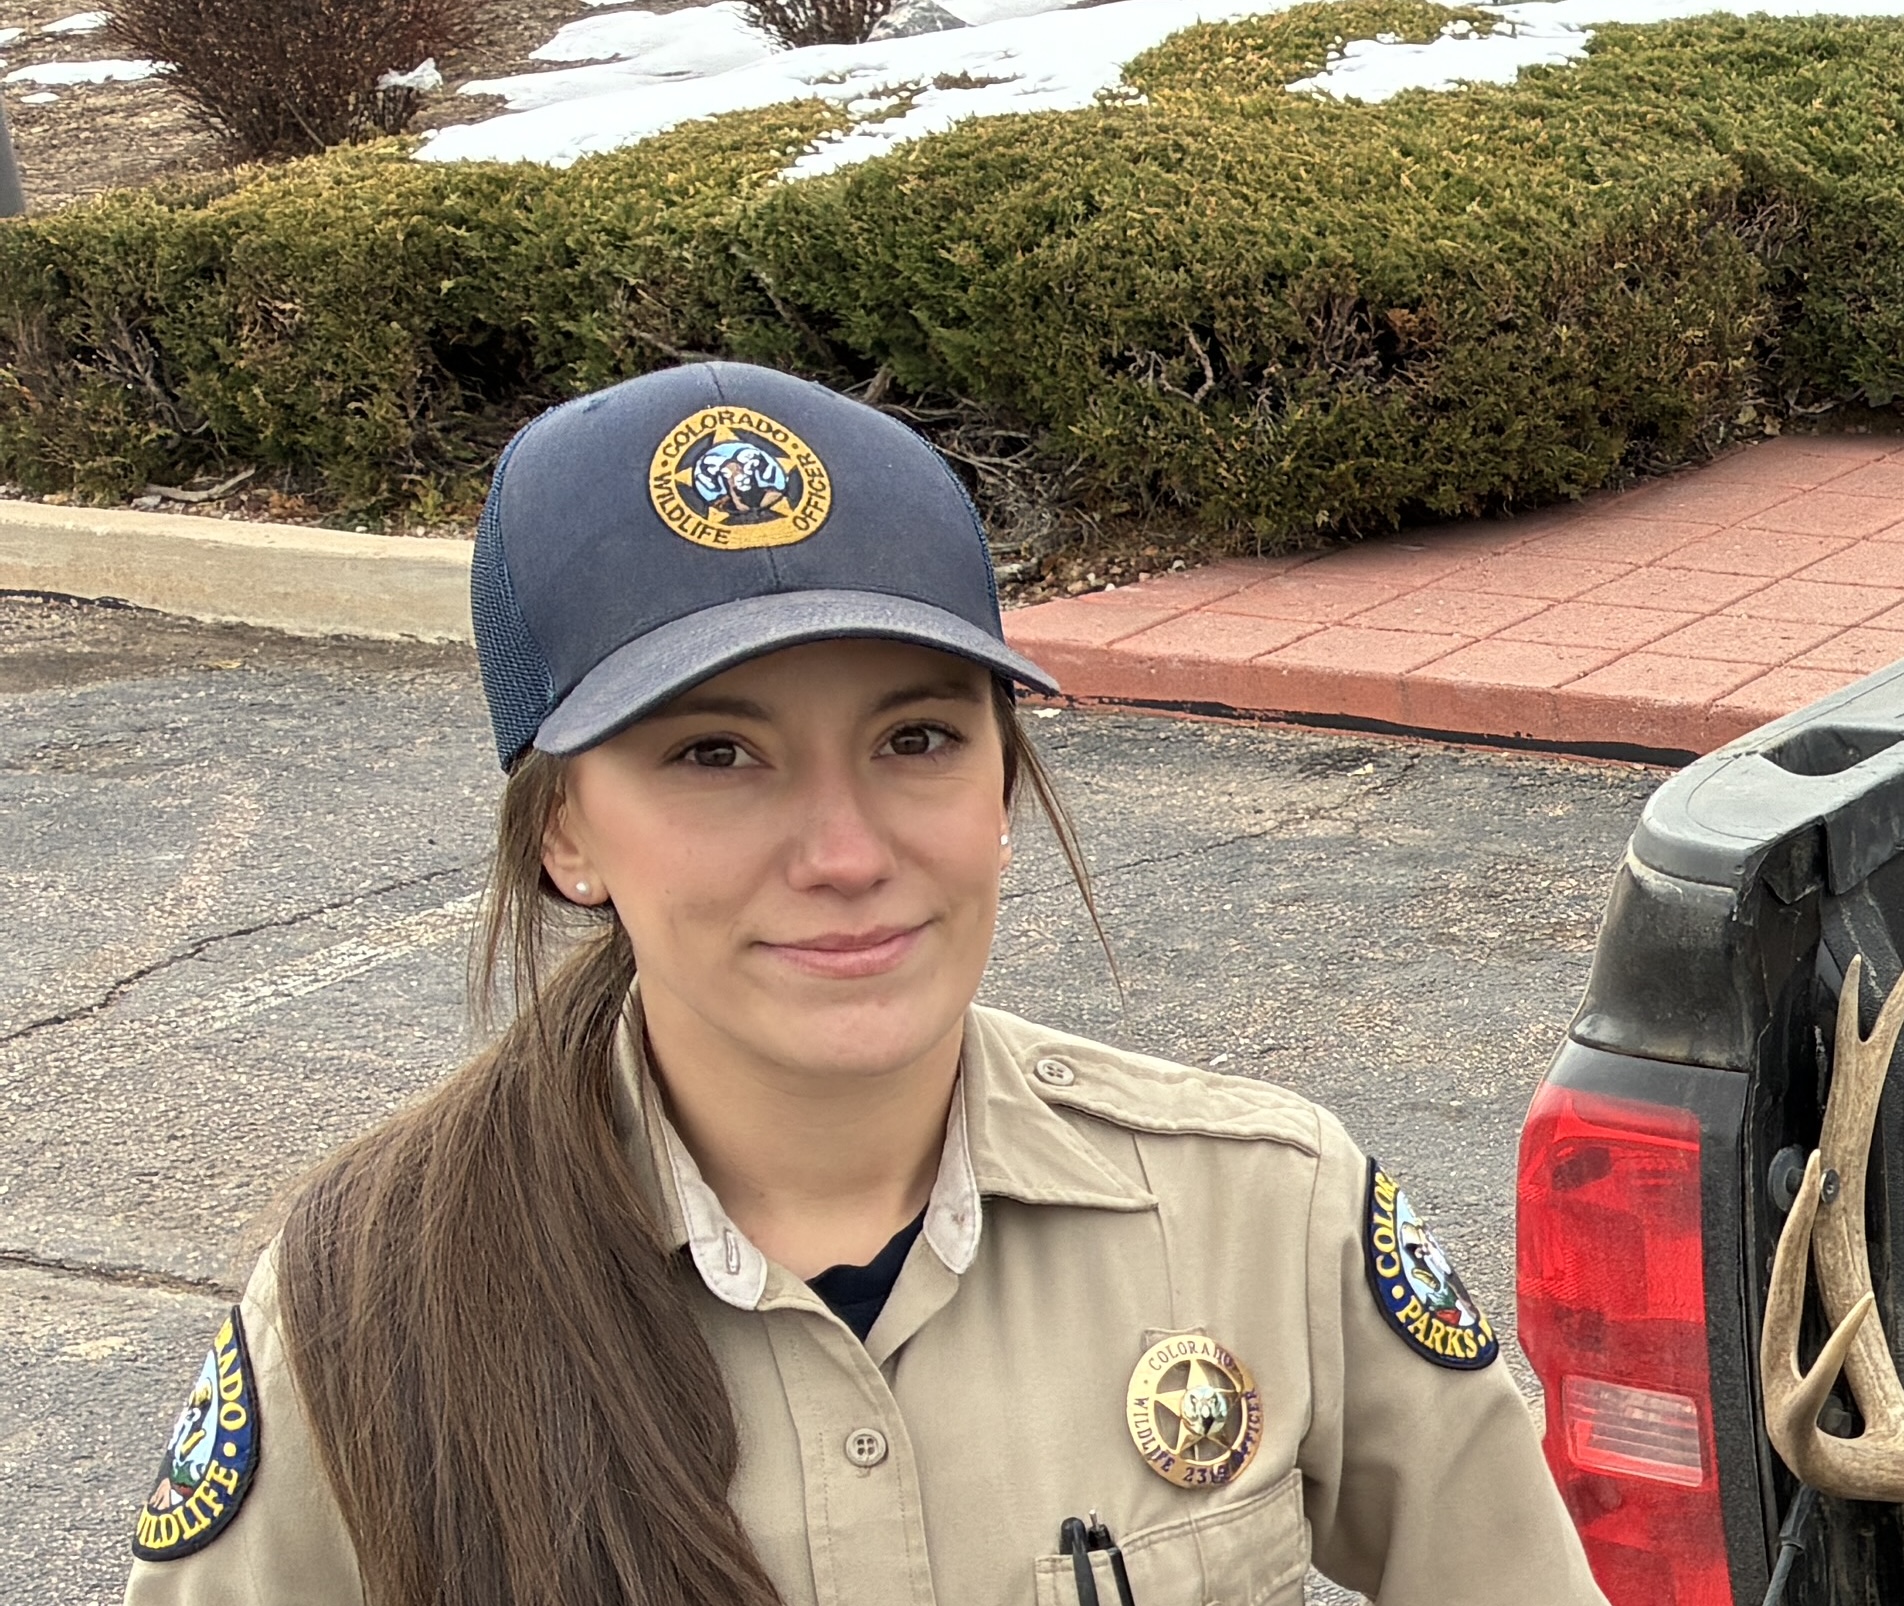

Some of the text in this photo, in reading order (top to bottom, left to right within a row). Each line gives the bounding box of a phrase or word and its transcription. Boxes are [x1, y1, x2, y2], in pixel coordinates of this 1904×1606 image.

[662, 410, 789, 458] COLORADO
[653, 471, 731, 545] WILDLIFE
[792, 453, 827, 531] OFFICER
[1395, 1295, 1478, 1359] PARKS
